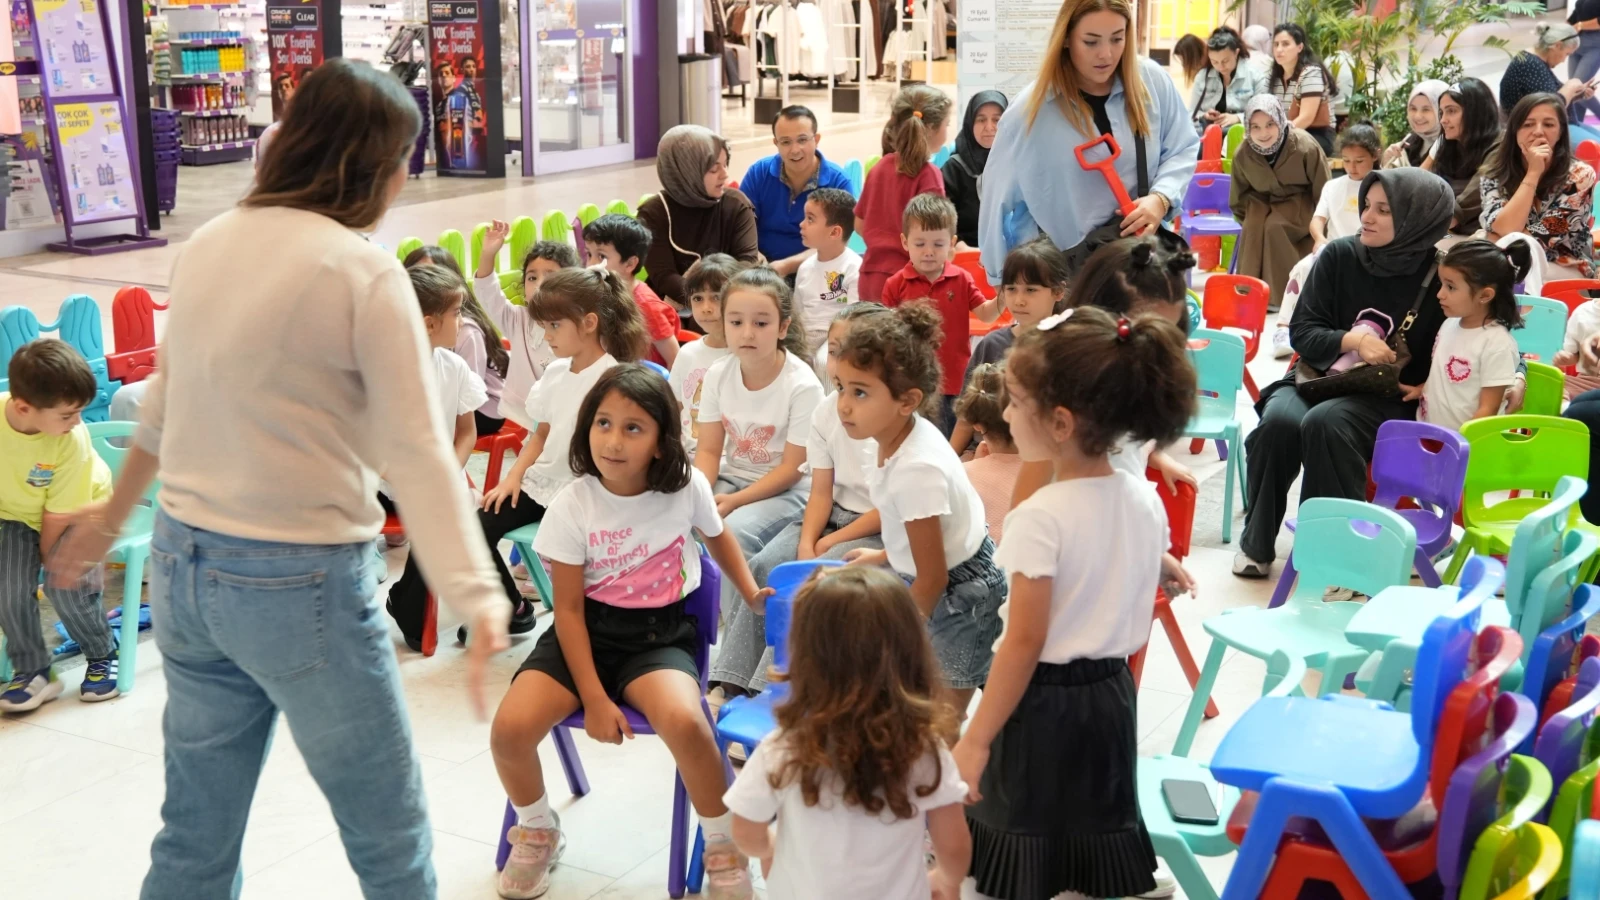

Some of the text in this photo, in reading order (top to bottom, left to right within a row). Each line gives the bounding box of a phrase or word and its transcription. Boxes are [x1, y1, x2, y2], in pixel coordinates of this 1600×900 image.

[450, 26, 476, 42] Enerjik
[290, 34, 316, 51] Enerjik
[589, 532, 599, 547] A
